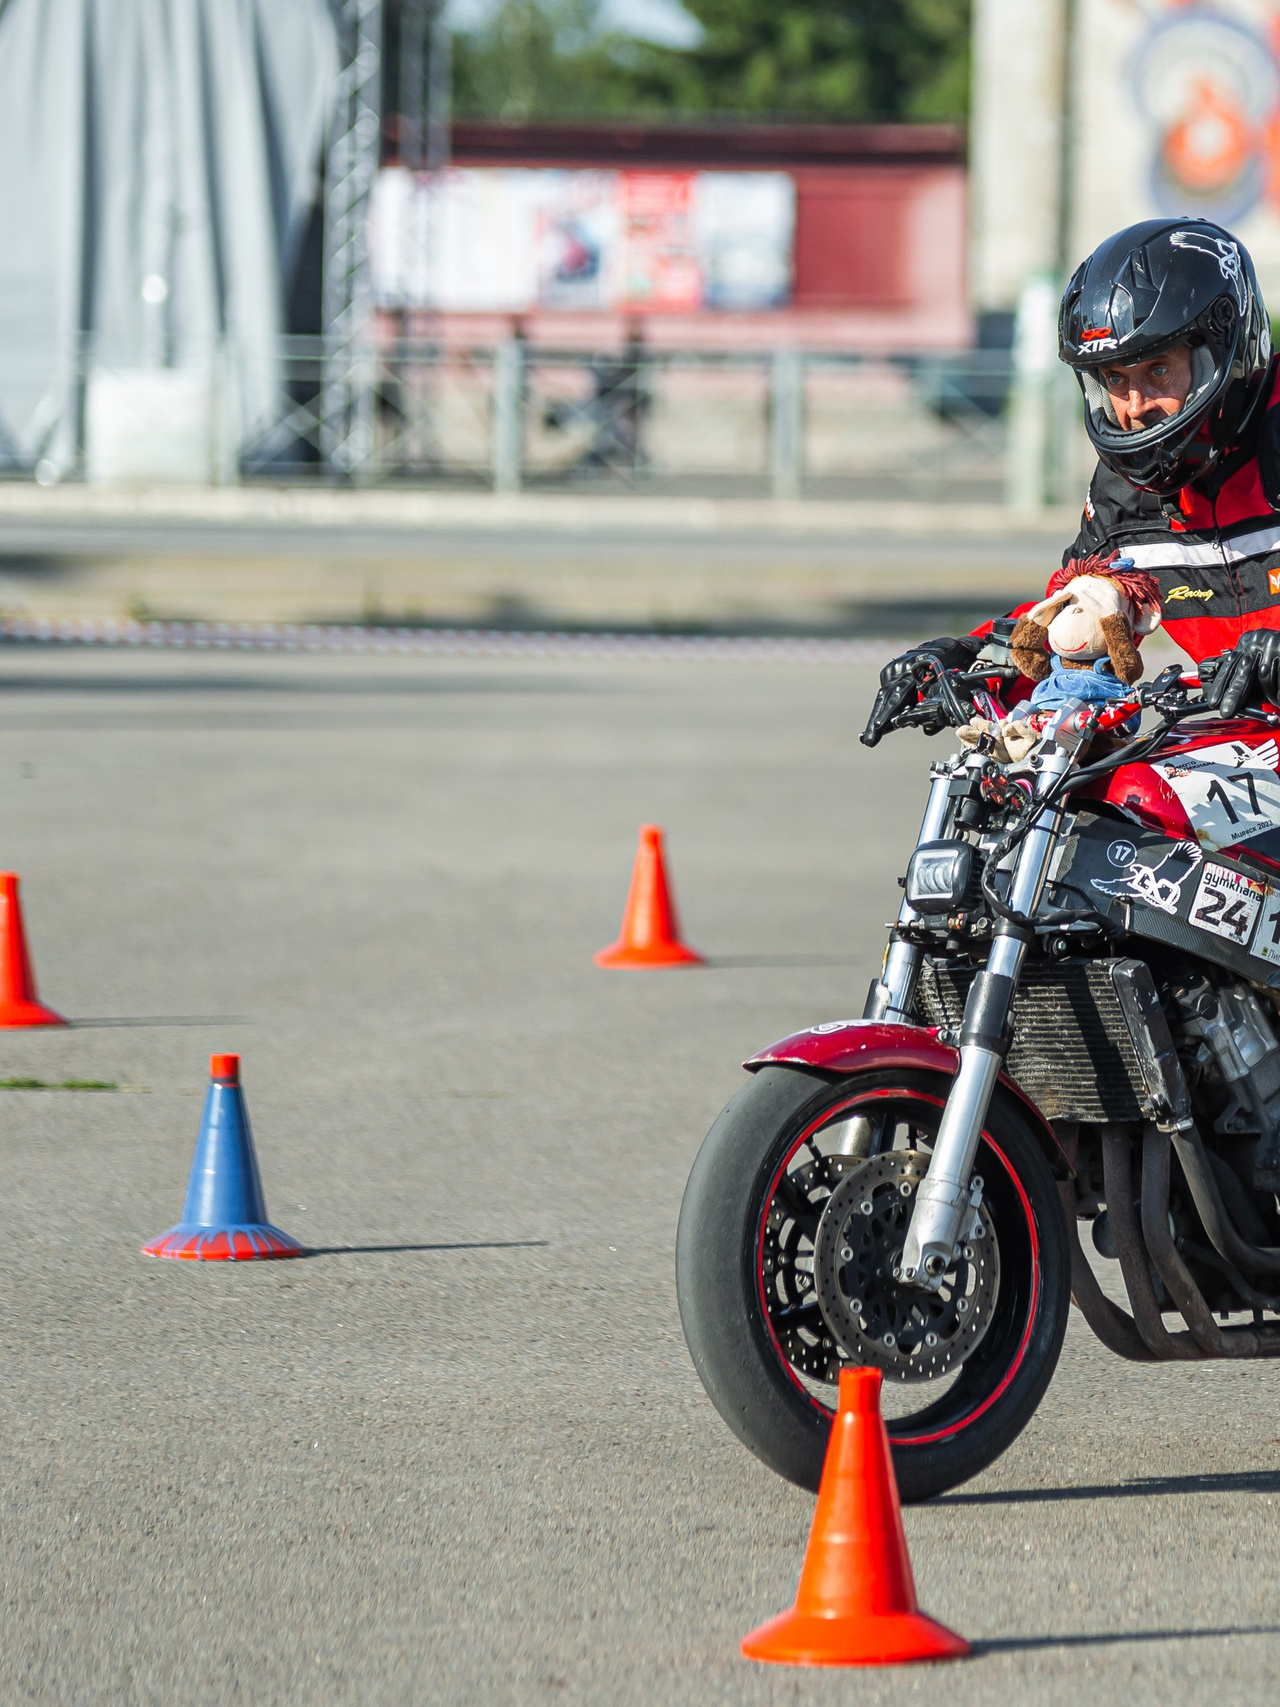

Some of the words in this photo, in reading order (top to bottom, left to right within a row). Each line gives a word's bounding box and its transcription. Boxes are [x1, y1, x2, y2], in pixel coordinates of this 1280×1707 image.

[1077, 337, 1118, 355] XTR
[1165, 585, 1214, 603] Racing
[1206, 771, 1263, 825] 17
[1114, 845, 1132, 862] 17
[1203, 872, 1262, 902] gymkhana
[1195, 886, 1248, 937] 24
